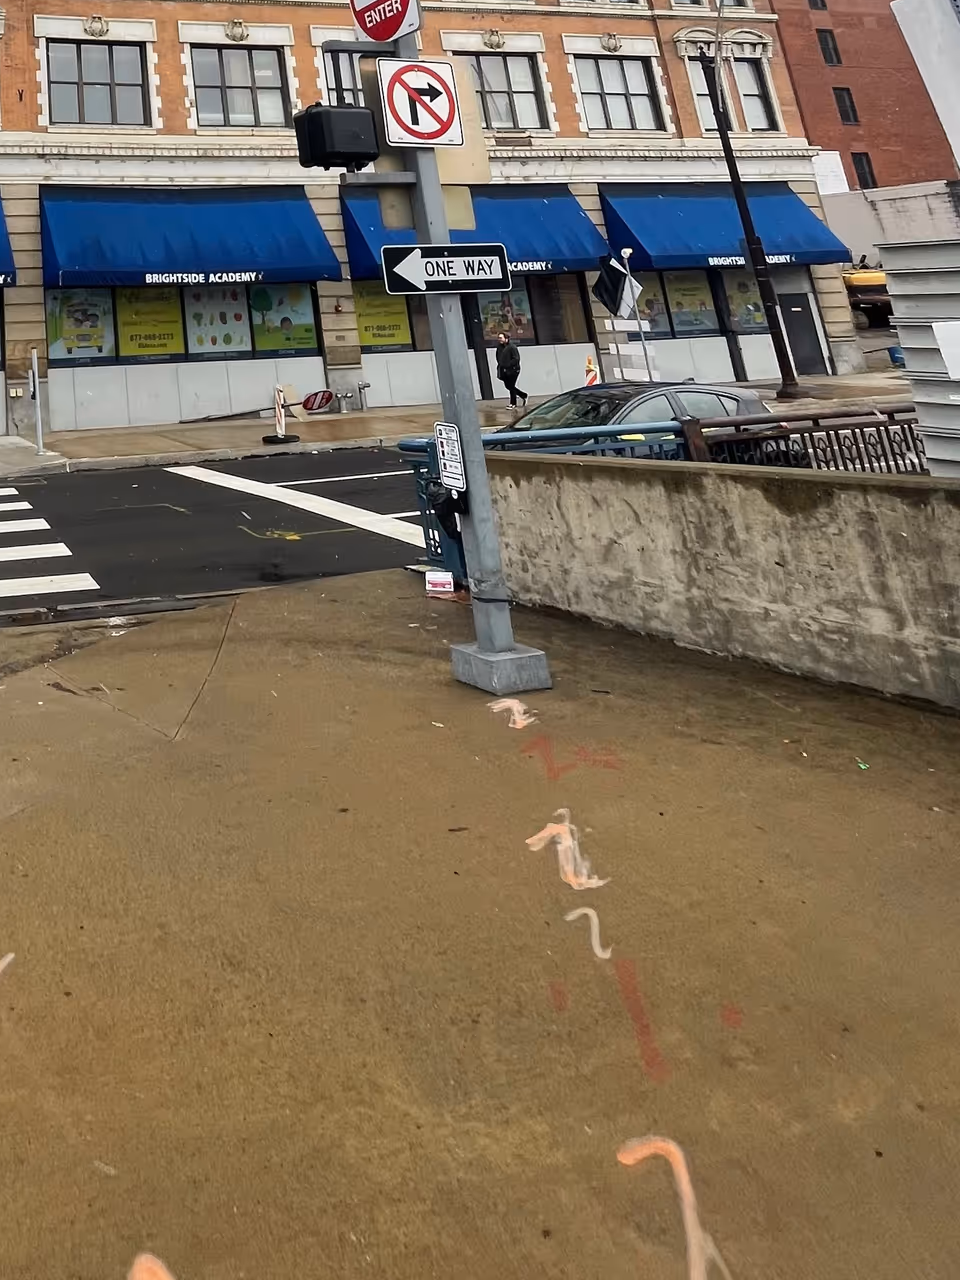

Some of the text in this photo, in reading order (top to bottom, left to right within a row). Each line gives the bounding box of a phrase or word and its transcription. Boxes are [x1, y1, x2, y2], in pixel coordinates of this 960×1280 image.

[425, 259, 494, 277] ONE WAY
[507, 261, 547, 272] ACADEMY
[145, 271, 257, 284] BRIGHTSIDE ACADEMY
